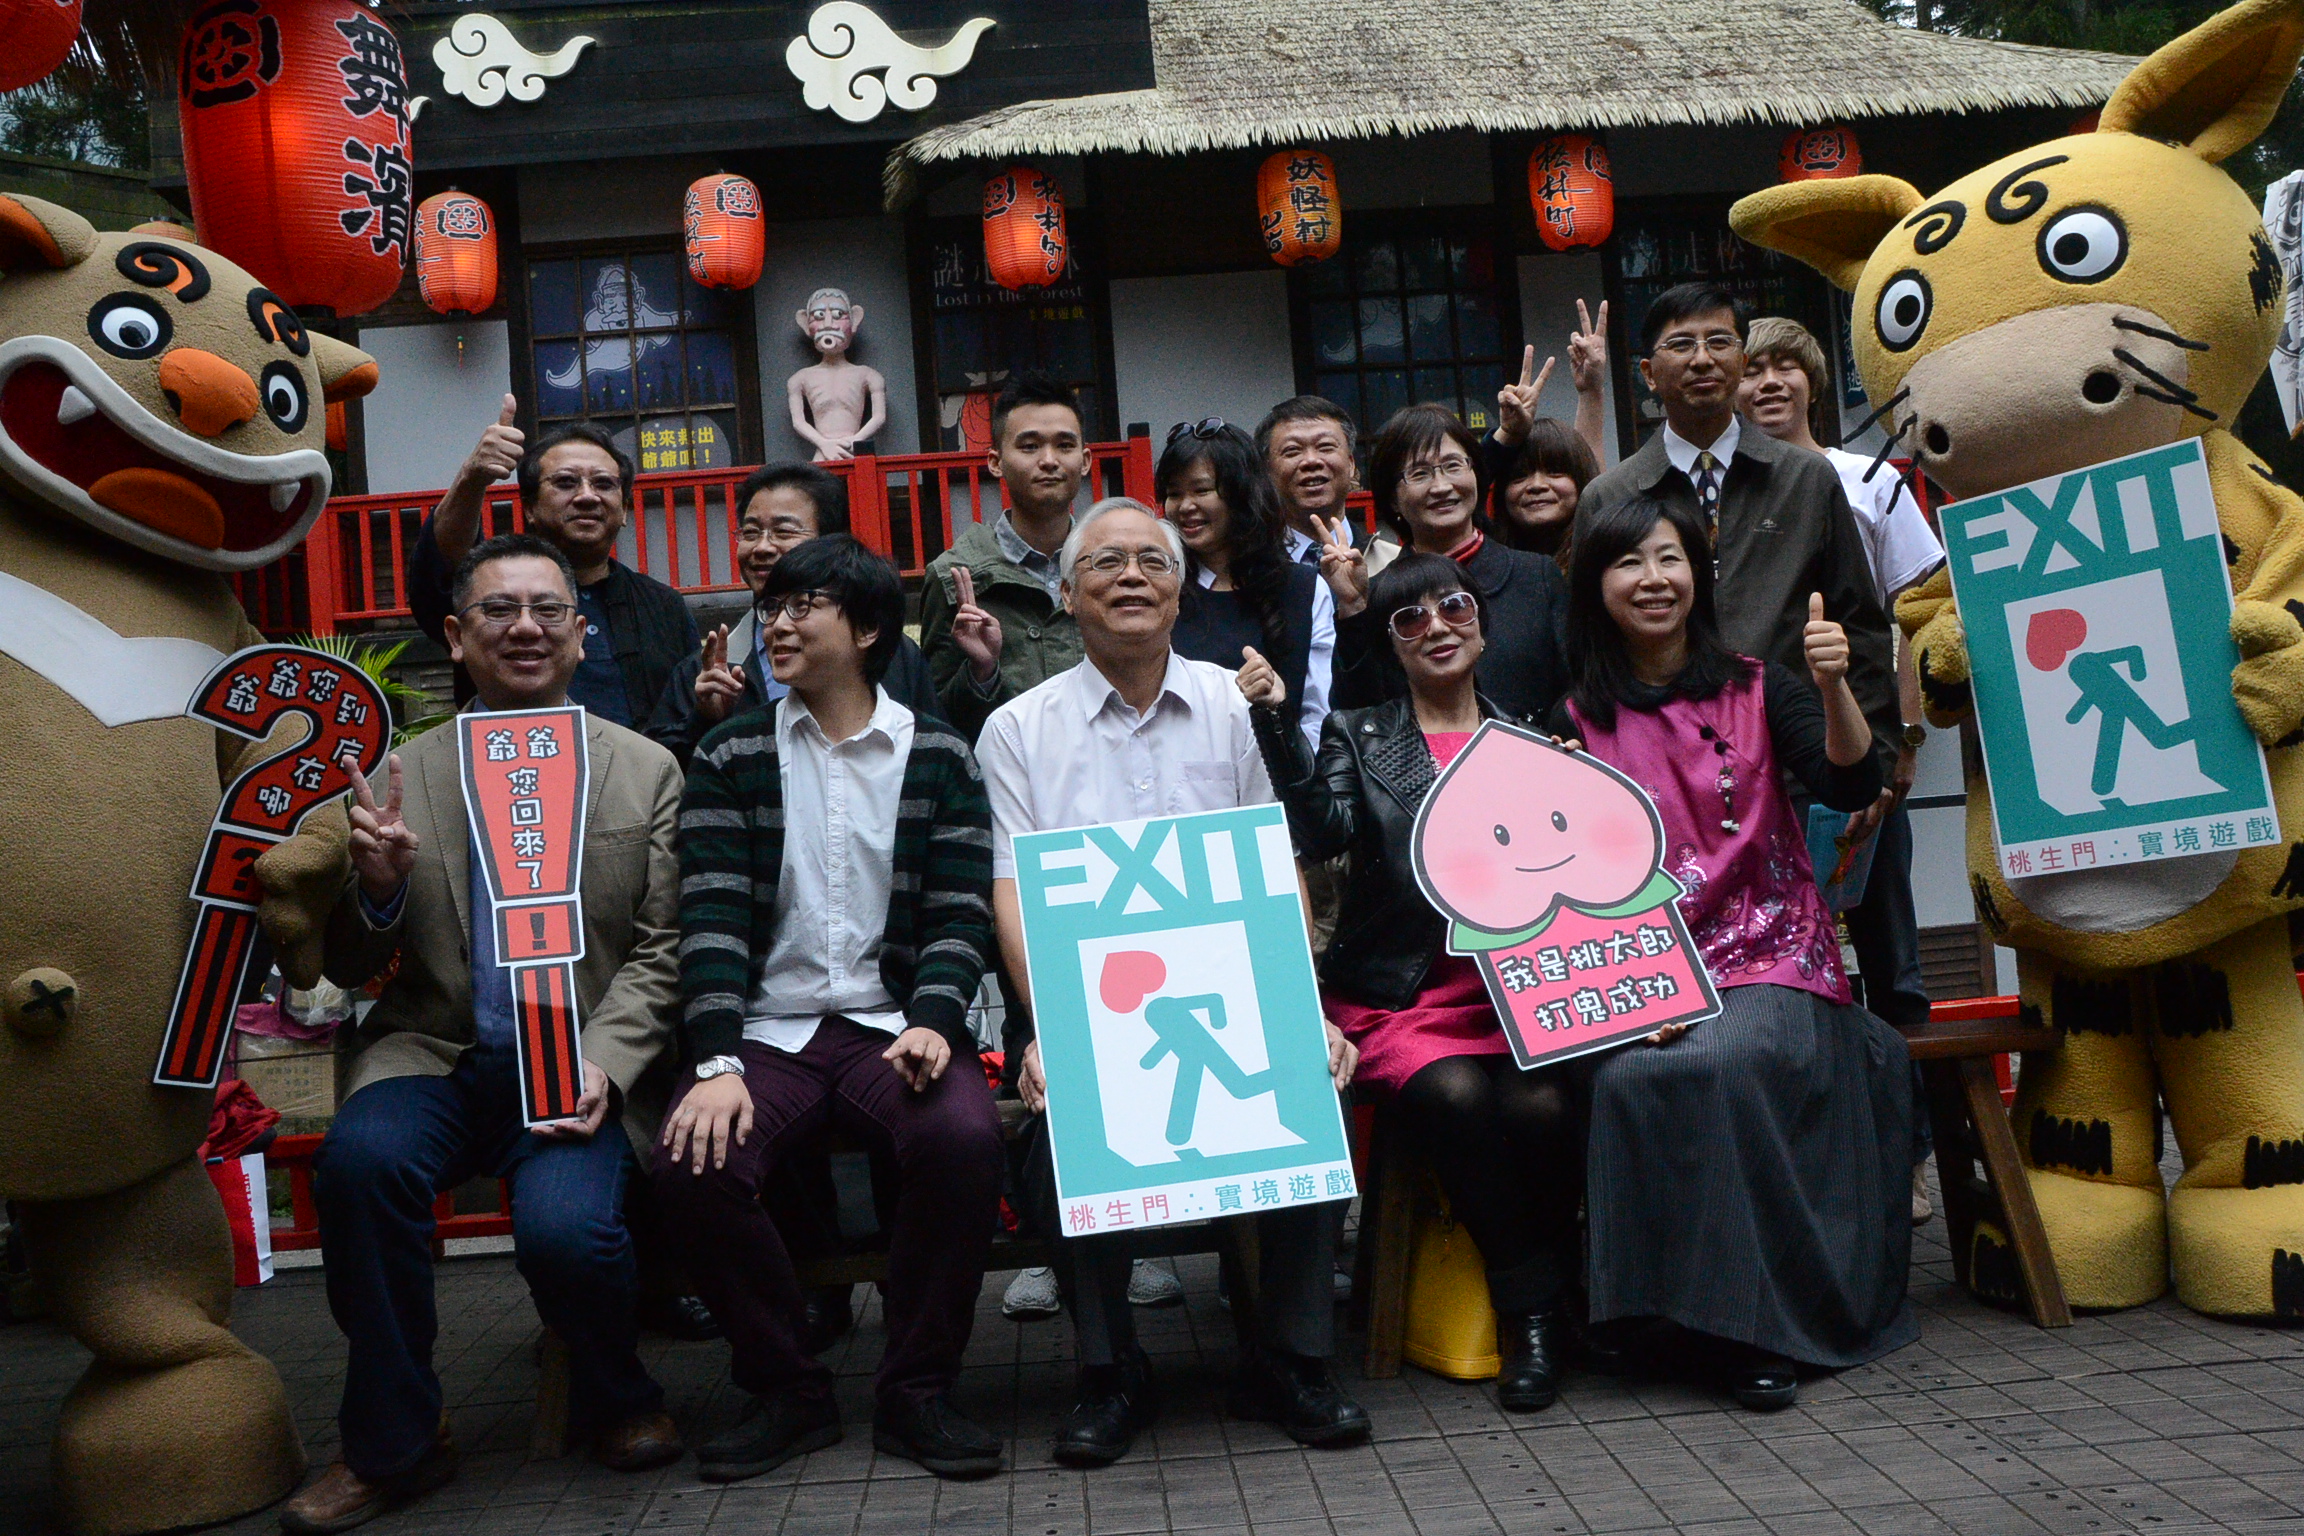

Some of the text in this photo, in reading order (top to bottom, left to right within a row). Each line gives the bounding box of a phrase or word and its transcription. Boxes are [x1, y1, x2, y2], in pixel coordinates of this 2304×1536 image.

[1286, 156, 1331, 243] 妖怪村
[935, 292, 969, 307] Lost
[998, 288, 1026, 302] the
[1040, 285, 1084, 300] orest
[641, 427, 715, 448] 快來救出
[1941, 440, 2201, 580] EXIT
[485, 727, 560, 761] 爺爺
[507, 768, 546, 889] 您回來了
[2008, 816, 2275, 875] 桃生門 實境遊戲
[1013, 806, 1286, 920] EXIT
[1498, 925, 1675, 993] 我是桃太郎
[1536, 975, 1677, 1032] 打鬼成功
[1068, 1168, 1355, 1233] 桃生門 實境遊戲
